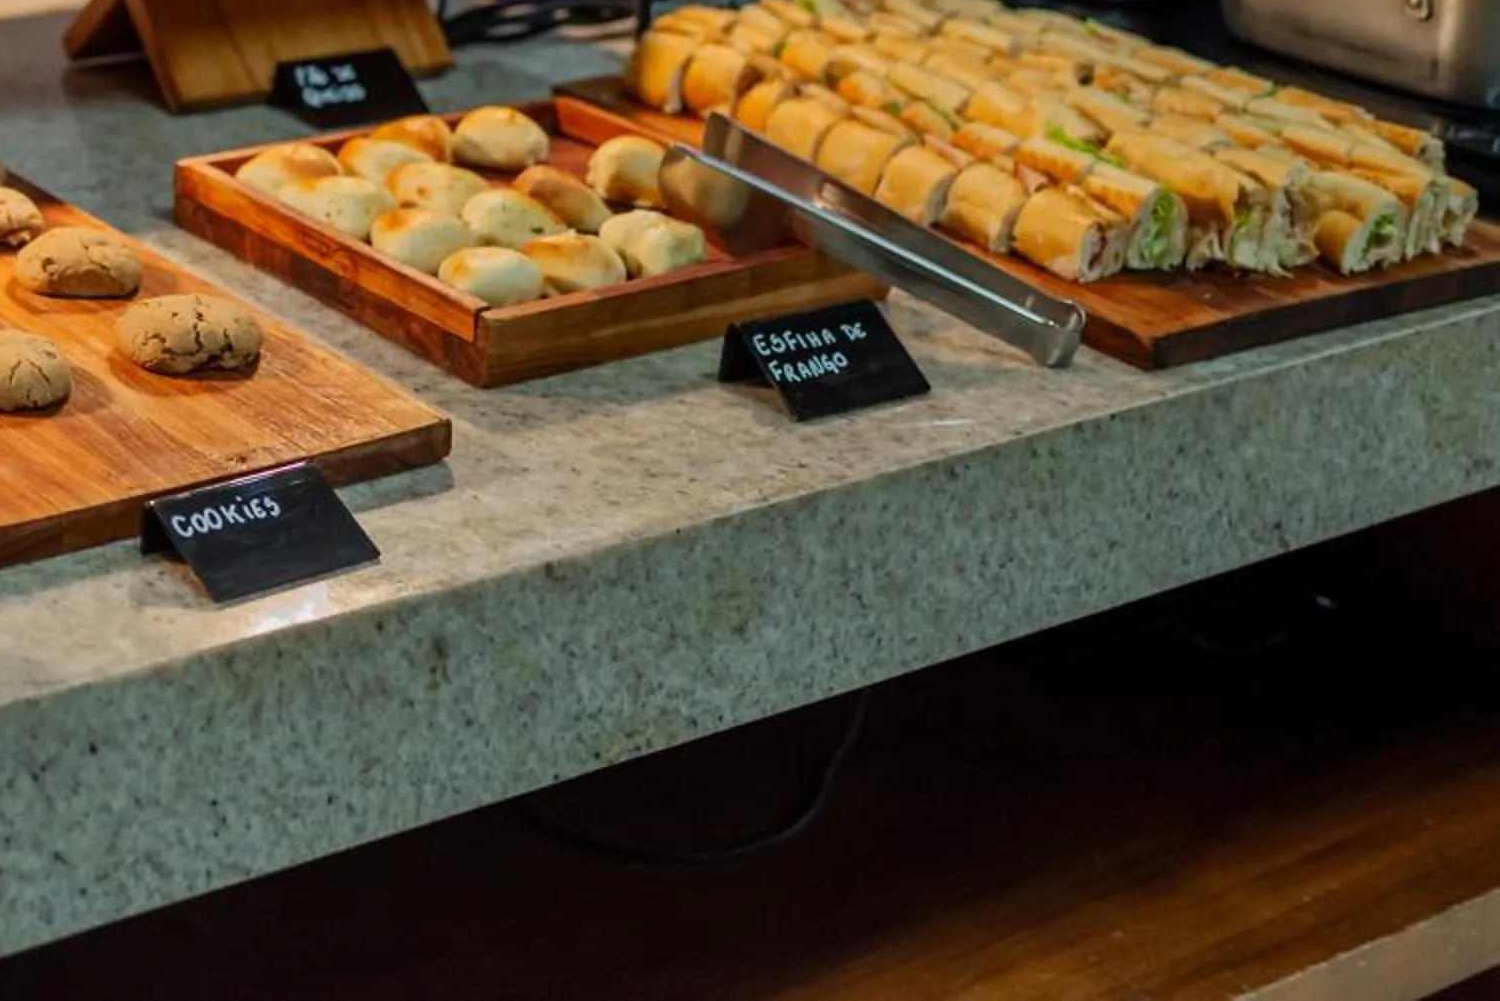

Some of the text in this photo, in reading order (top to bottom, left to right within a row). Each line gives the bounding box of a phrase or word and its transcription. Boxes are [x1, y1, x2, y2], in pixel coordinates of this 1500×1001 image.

[751, 322, 868, 357] ESFIHA DE
[767, 351, 850, 384] FRANGO
